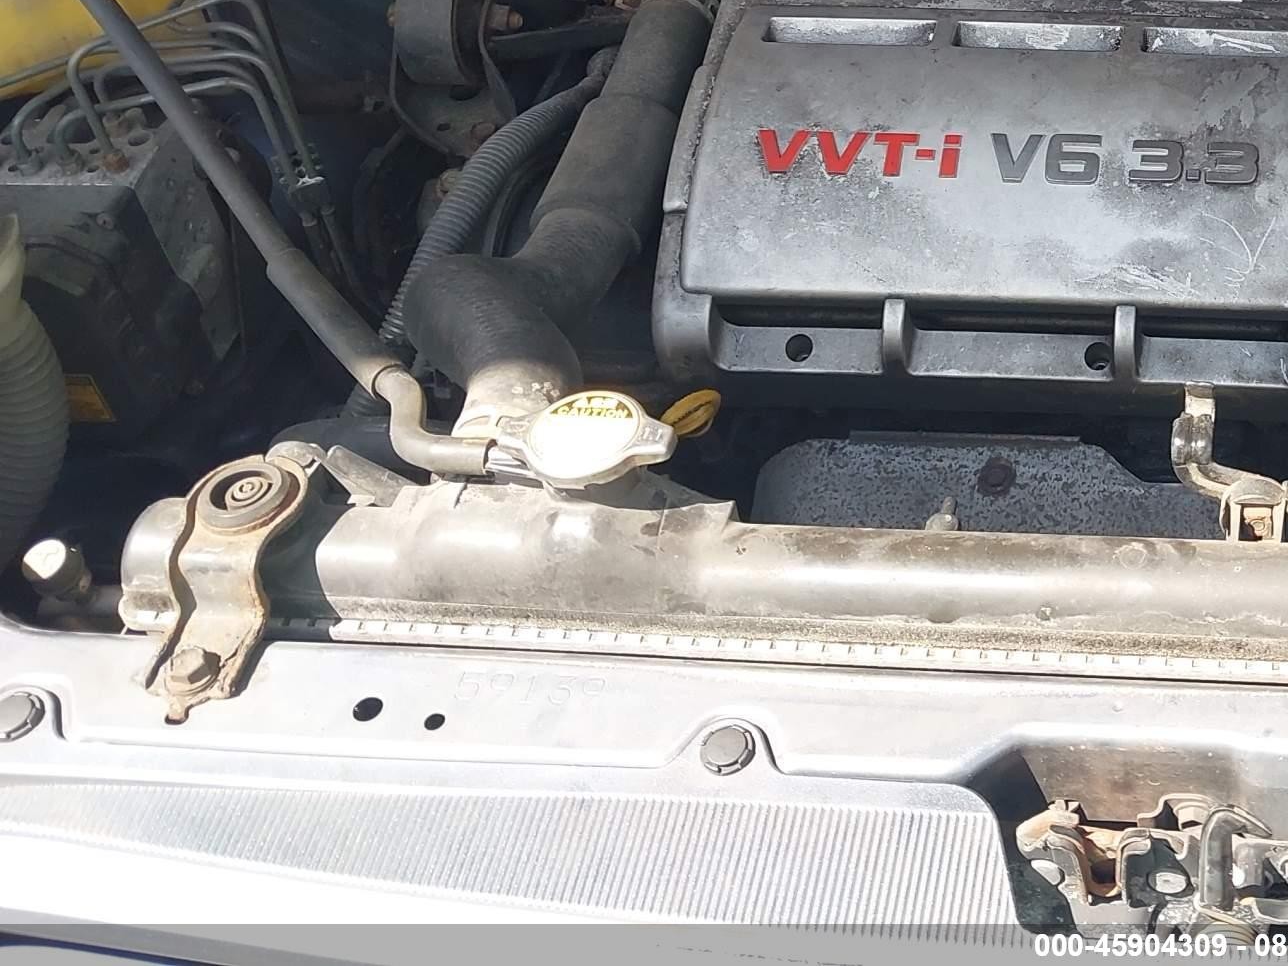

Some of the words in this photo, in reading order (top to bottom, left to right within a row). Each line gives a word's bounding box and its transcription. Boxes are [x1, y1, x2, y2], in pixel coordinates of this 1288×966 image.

[757, 129, 962, 179] VVT-i
[990, 133, 1104, 185] V6
[1128, 139, 1261, 185] 3.3
[557, 406, 629, 419] CAUTION
